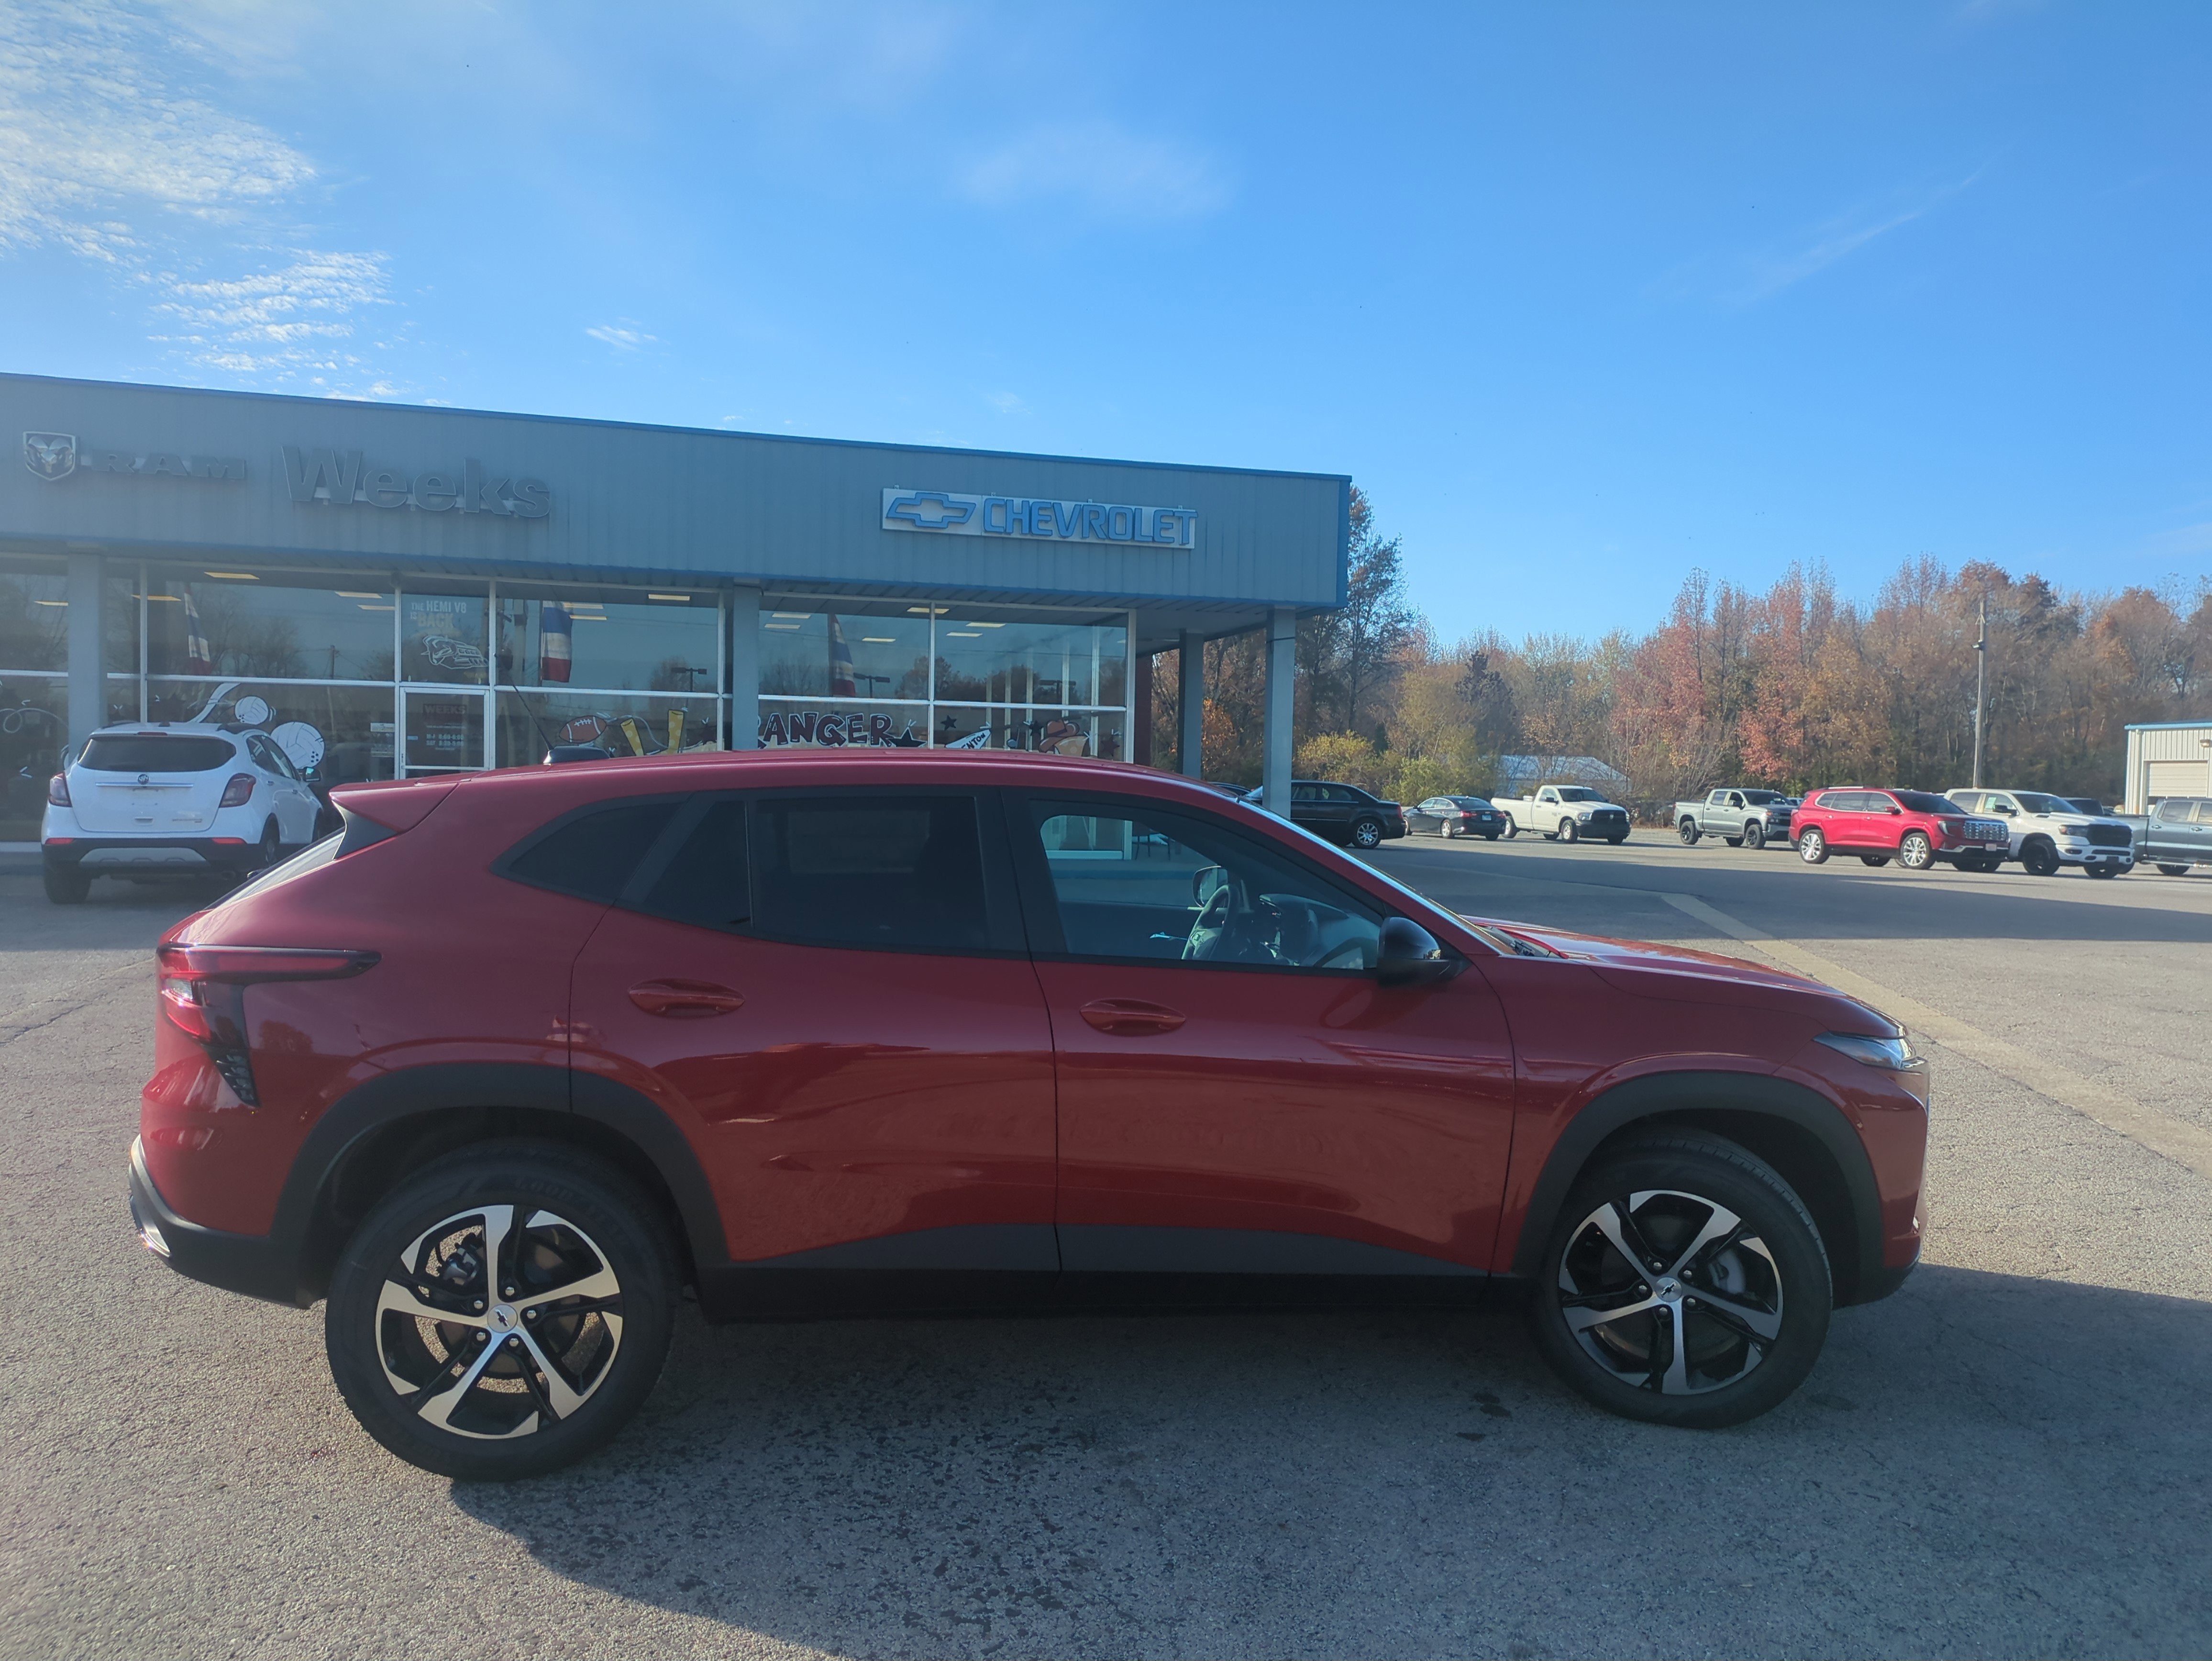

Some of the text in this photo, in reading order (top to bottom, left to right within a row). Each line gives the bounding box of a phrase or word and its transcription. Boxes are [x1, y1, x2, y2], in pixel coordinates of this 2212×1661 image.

[91, 450, 246, 480] RAM
[281, 446, 551, 518] Weeks
[983, 498, 1198, 545] CHEVROLET
[411, 600, 466, 613] THE HEMI V8
[417, 611, 453, 628] BACK
[424, 704, 465, 714] WEEKS
[758, 712, 896, 749] ANGER
